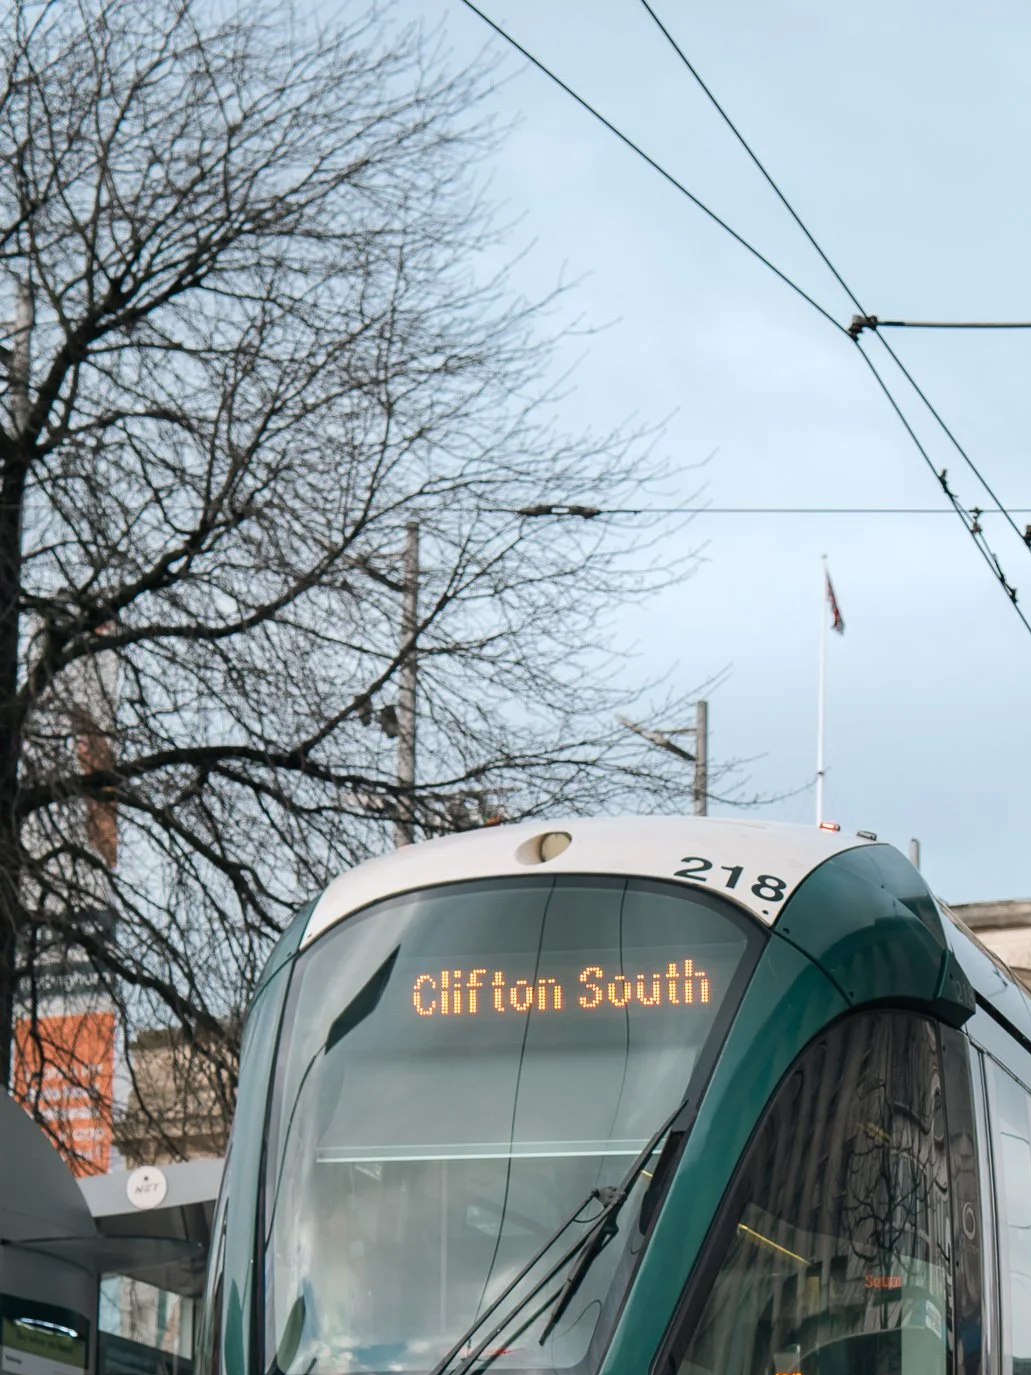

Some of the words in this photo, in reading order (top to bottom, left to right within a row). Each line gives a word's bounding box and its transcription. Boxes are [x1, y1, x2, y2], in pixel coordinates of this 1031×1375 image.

[673, 856, 787, 903] 218
[412, 968, 563, 1016] Clifton
[579, 959, 709, 1008] South
